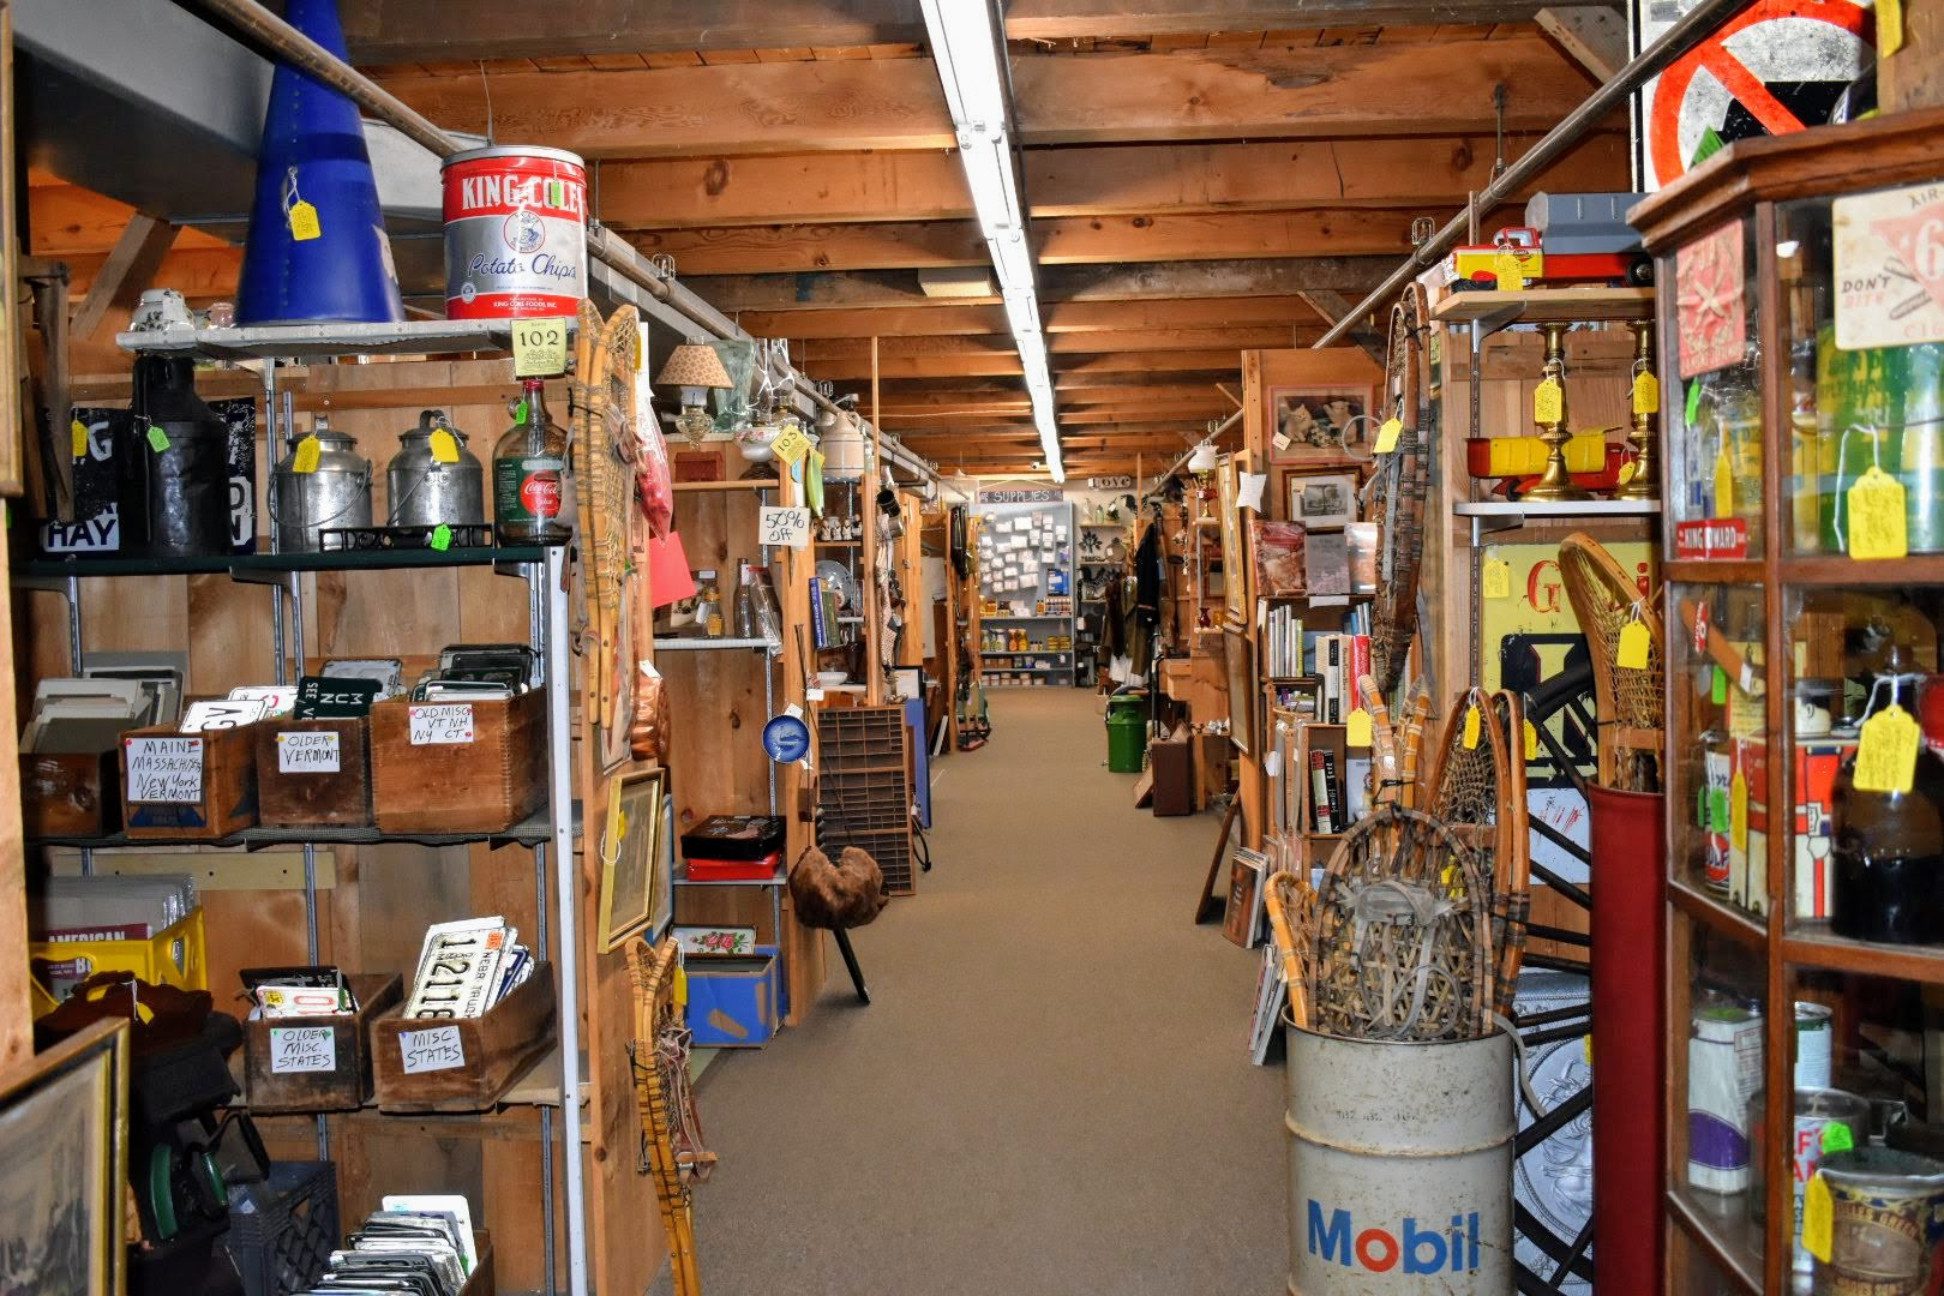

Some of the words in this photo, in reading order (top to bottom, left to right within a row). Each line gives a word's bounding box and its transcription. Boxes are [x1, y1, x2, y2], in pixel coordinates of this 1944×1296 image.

[462, 174, 520, 210] KING
[1841, 274, 1891, 294] DON'T
[520, 330, 559, 347] 102
[994, 490, 1050, 503] SUPPLIES
[766, 511, 805, 529] 50%
[144, 741, 200, 755] MAINE
[287, 734, 332, 746] OLDER
[284, 748, 340, 765] VERMONT
[140, 788, 201, 801] VERMONT
[283, 1030, 328, 1041] OLDER
[276, 1054, 331, 1068] STATES
[407, 1044, 462, 1068] STATES
[1307, 1198, 1480, 1276] Mobil
